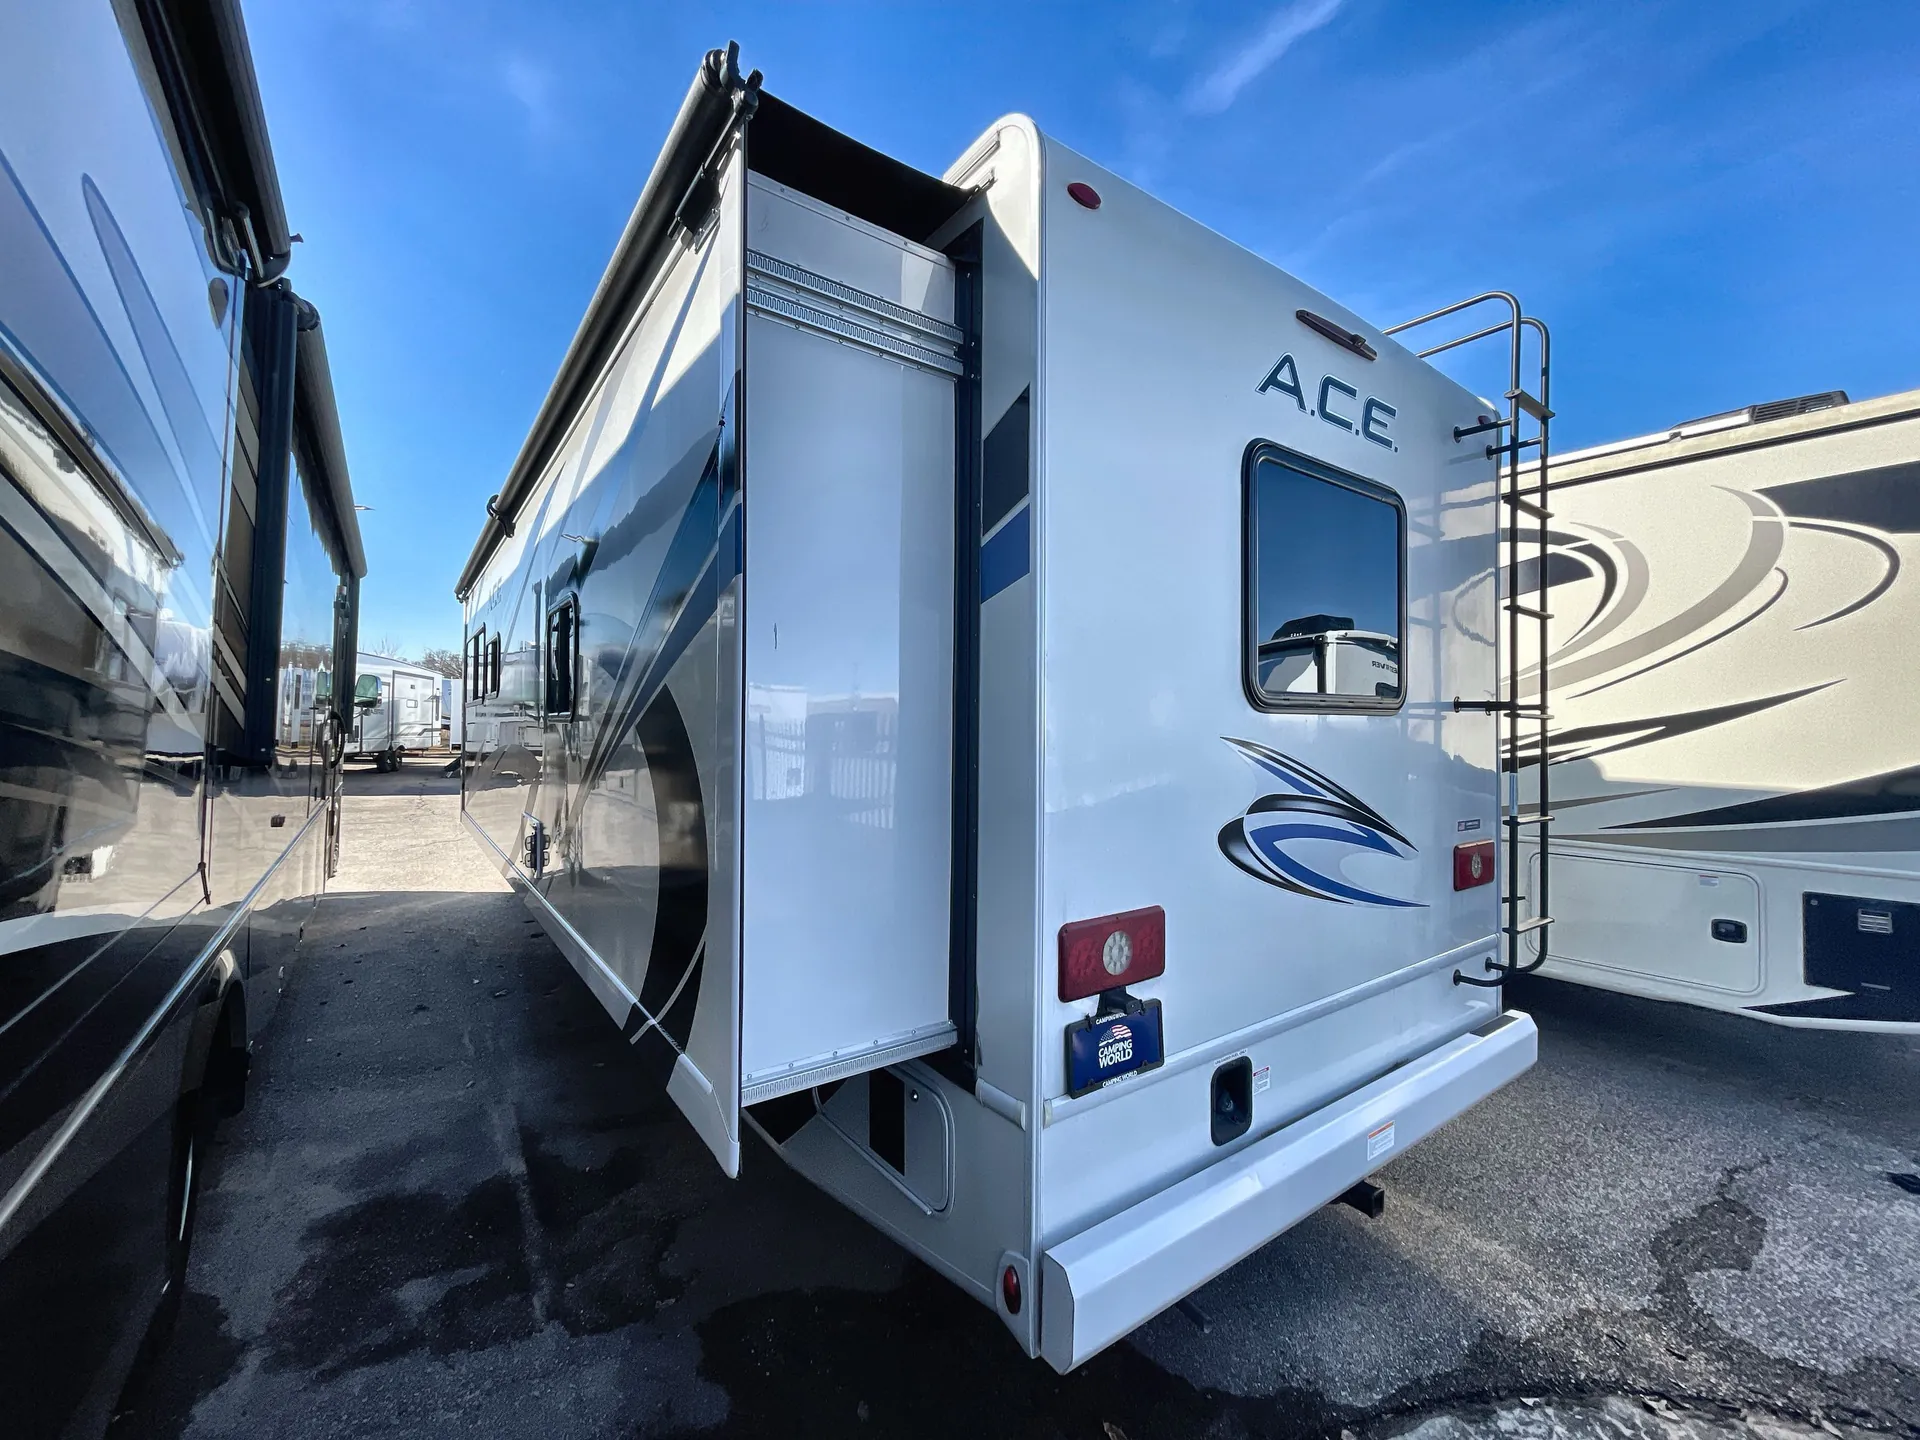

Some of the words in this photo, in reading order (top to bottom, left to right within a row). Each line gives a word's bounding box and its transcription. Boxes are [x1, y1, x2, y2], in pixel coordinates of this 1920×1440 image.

[1255, 352, 1398, 453] A.C.E.
[1098, 1039, 1133, 1058] CAMPING
[1098, 1049, 1133, 1069] WORLD
[1102, 1075, 1122, 1088] CAMPING
[1122, 1070, 1138, 1081] WORLD
